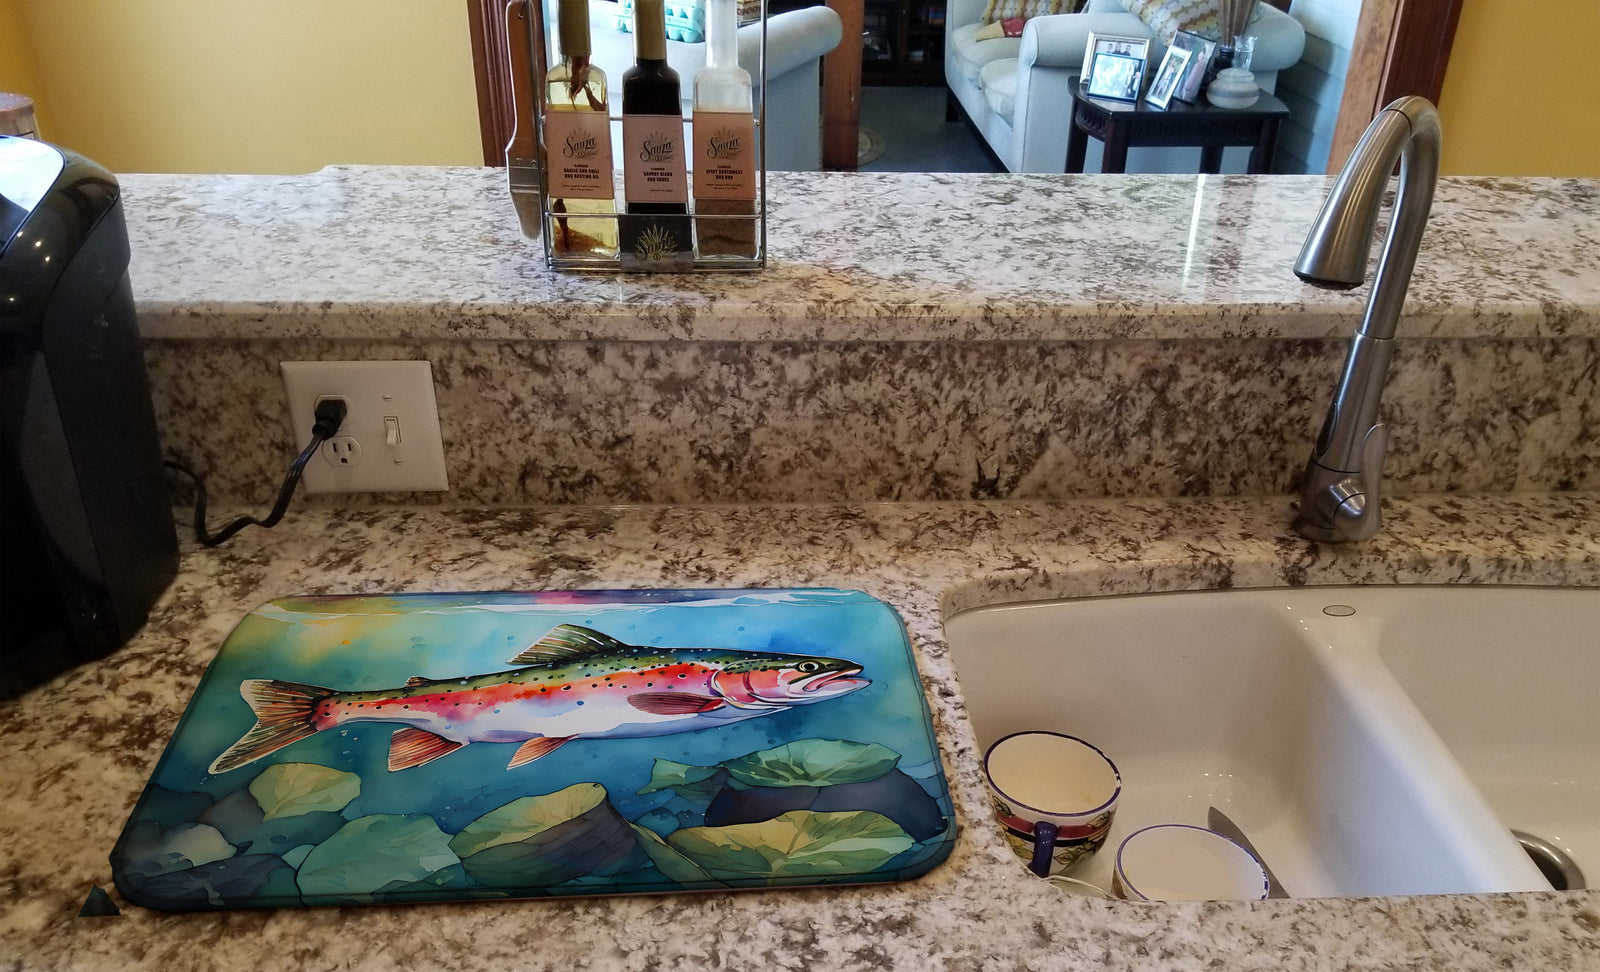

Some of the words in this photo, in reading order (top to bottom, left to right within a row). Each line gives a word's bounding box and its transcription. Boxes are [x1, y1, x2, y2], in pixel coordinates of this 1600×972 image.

[563, 136, 597, 158] Sauza
[640, 140, 673, 161] Sauza
[707, 137, 740, 158] Sauza
